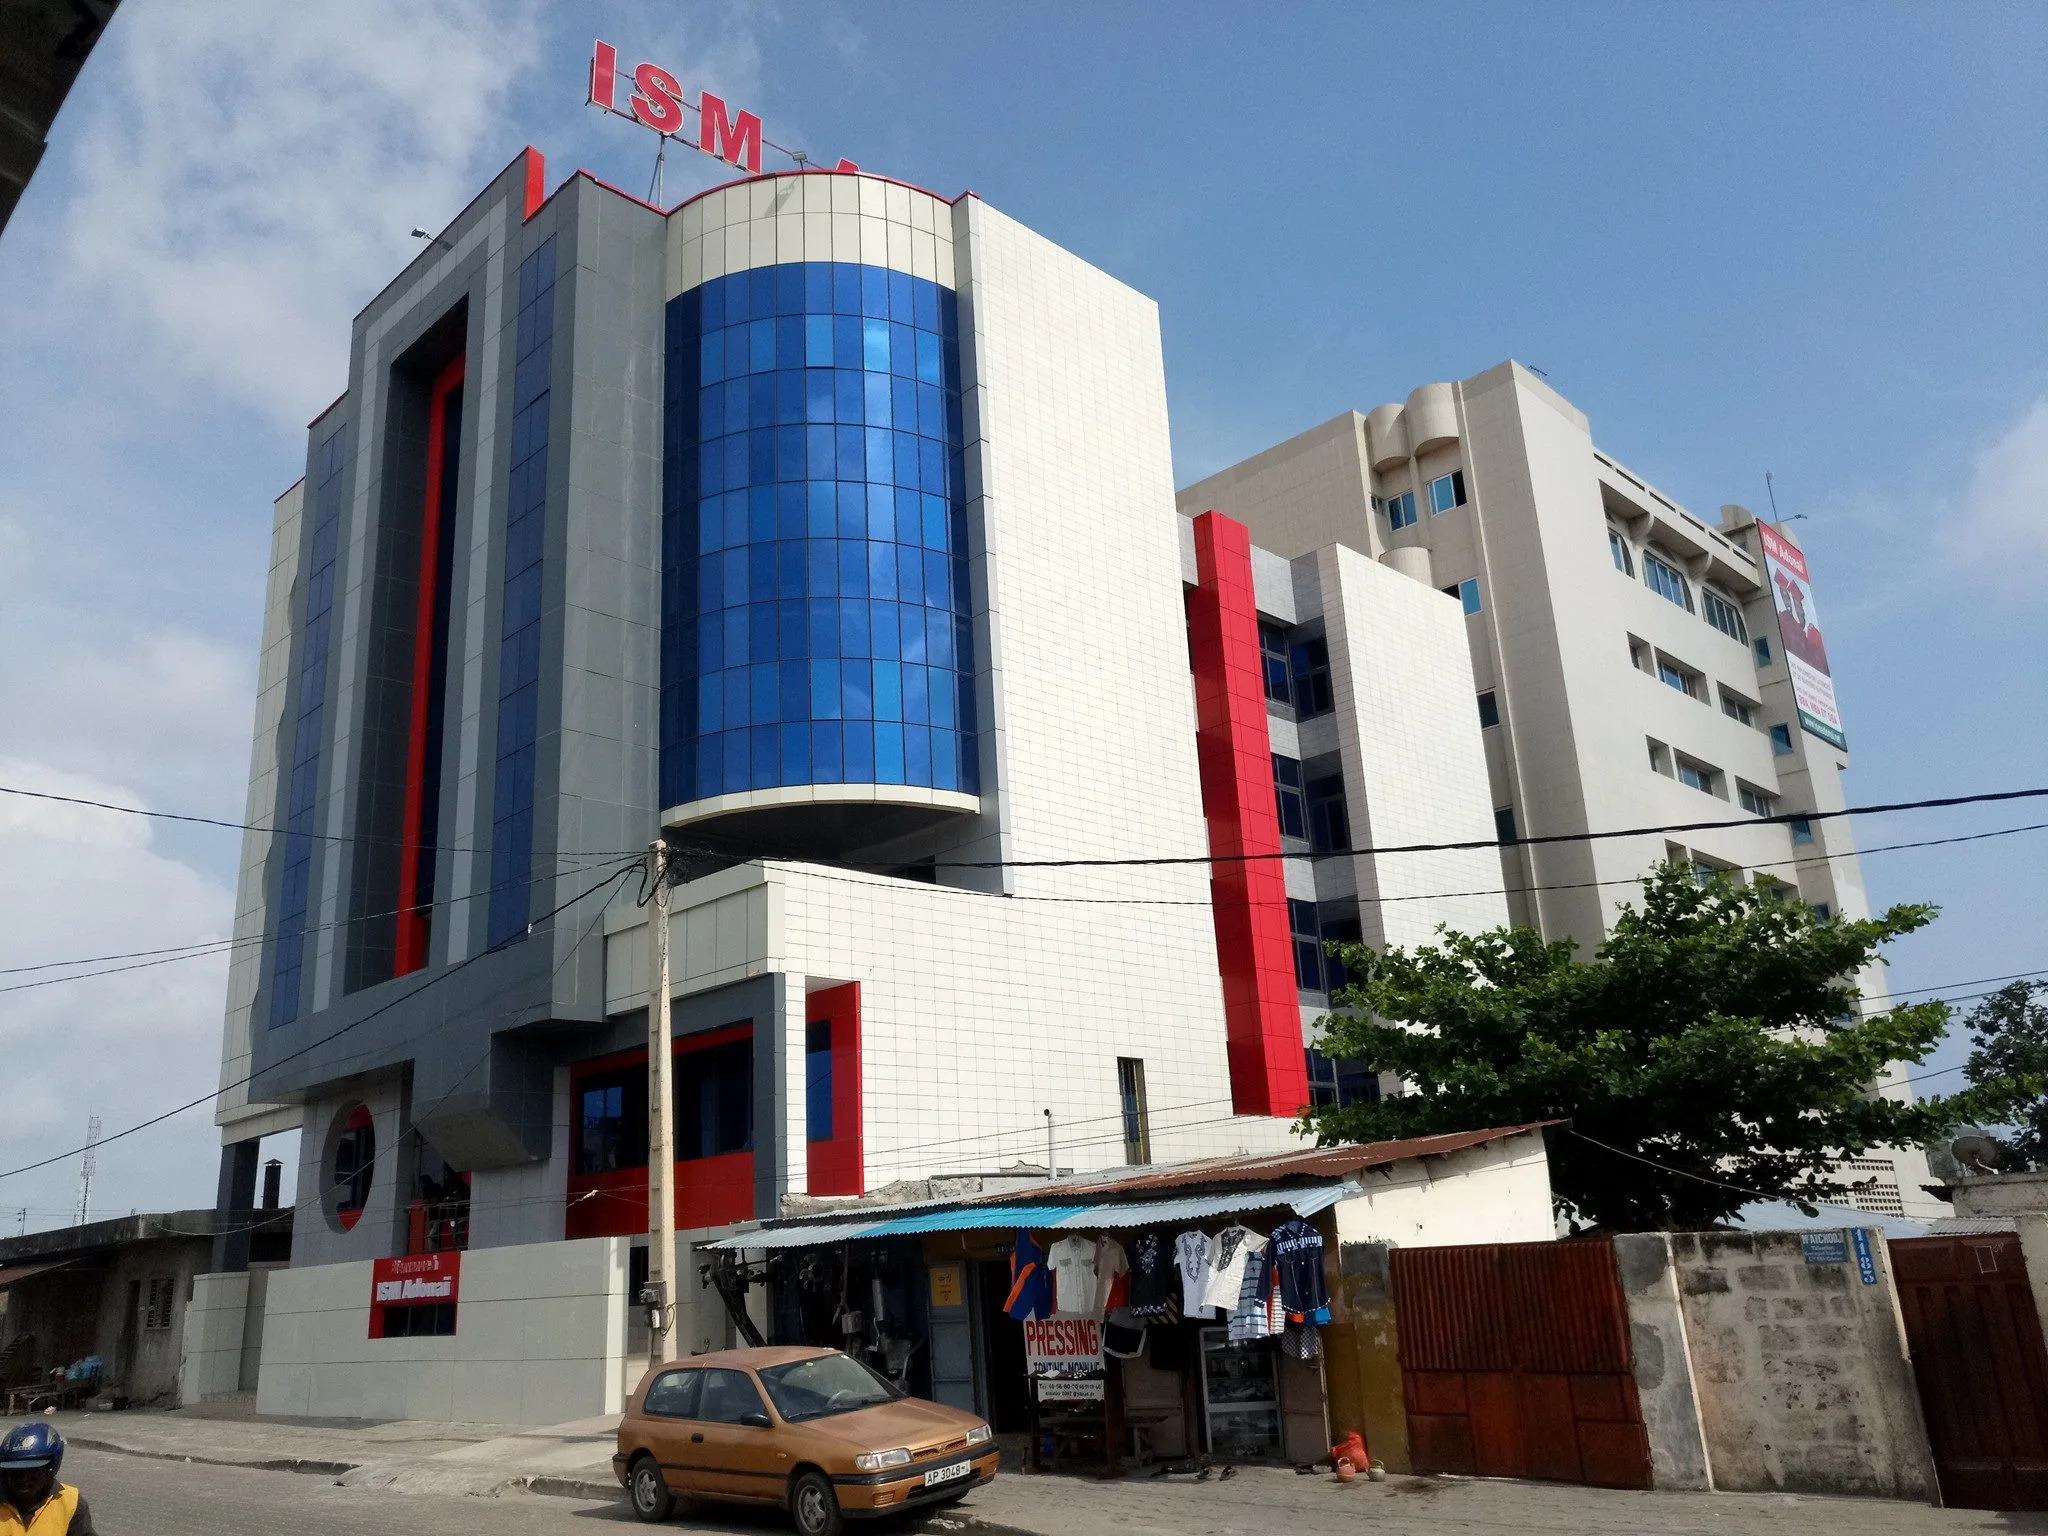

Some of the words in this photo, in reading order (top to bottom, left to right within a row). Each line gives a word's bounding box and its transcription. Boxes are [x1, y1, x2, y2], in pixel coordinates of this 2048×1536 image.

[591, 38, 762, 176] ISM
[376, 1280, 402, 1302] ISM
[1025, 1319, 1100, 1356] PRESSING
[927, 1471, 939, 1484] AP
